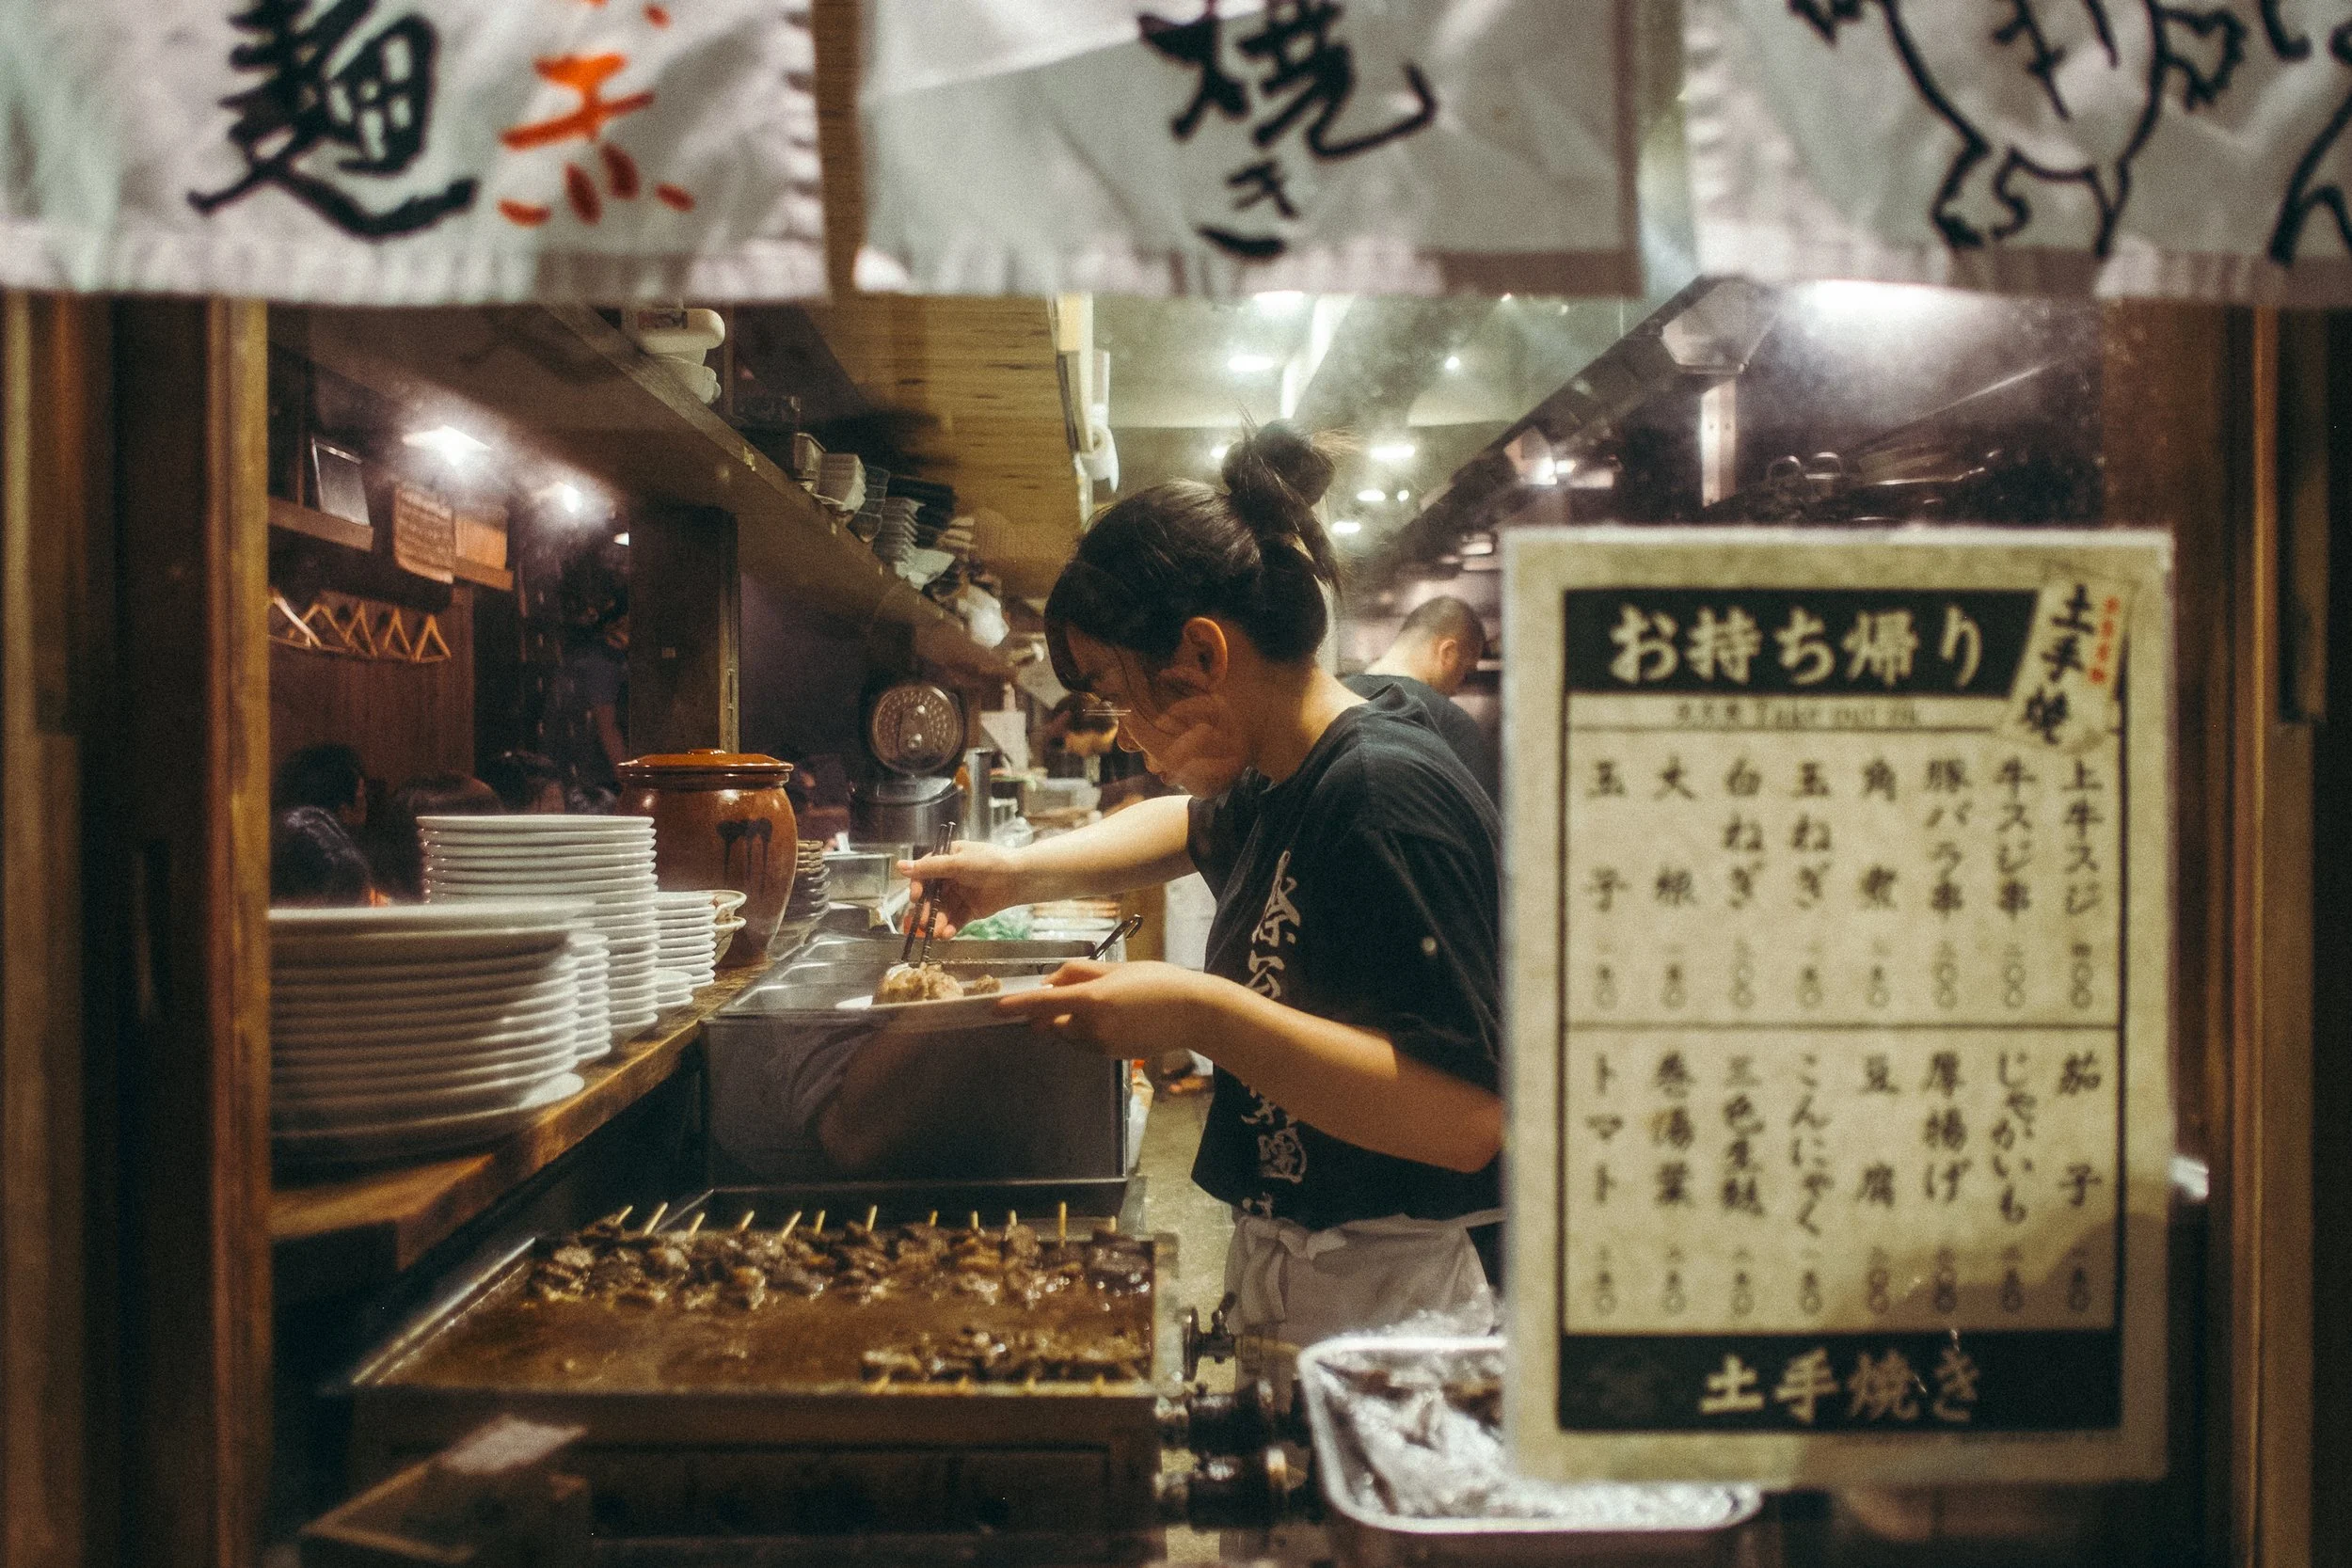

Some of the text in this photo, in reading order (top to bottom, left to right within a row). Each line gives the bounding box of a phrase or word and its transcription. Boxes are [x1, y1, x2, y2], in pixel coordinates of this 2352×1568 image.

[1611, 606, 1980, 685] お持ち帰り
[1699, 1347, 1979, 1422] 土手焼き
